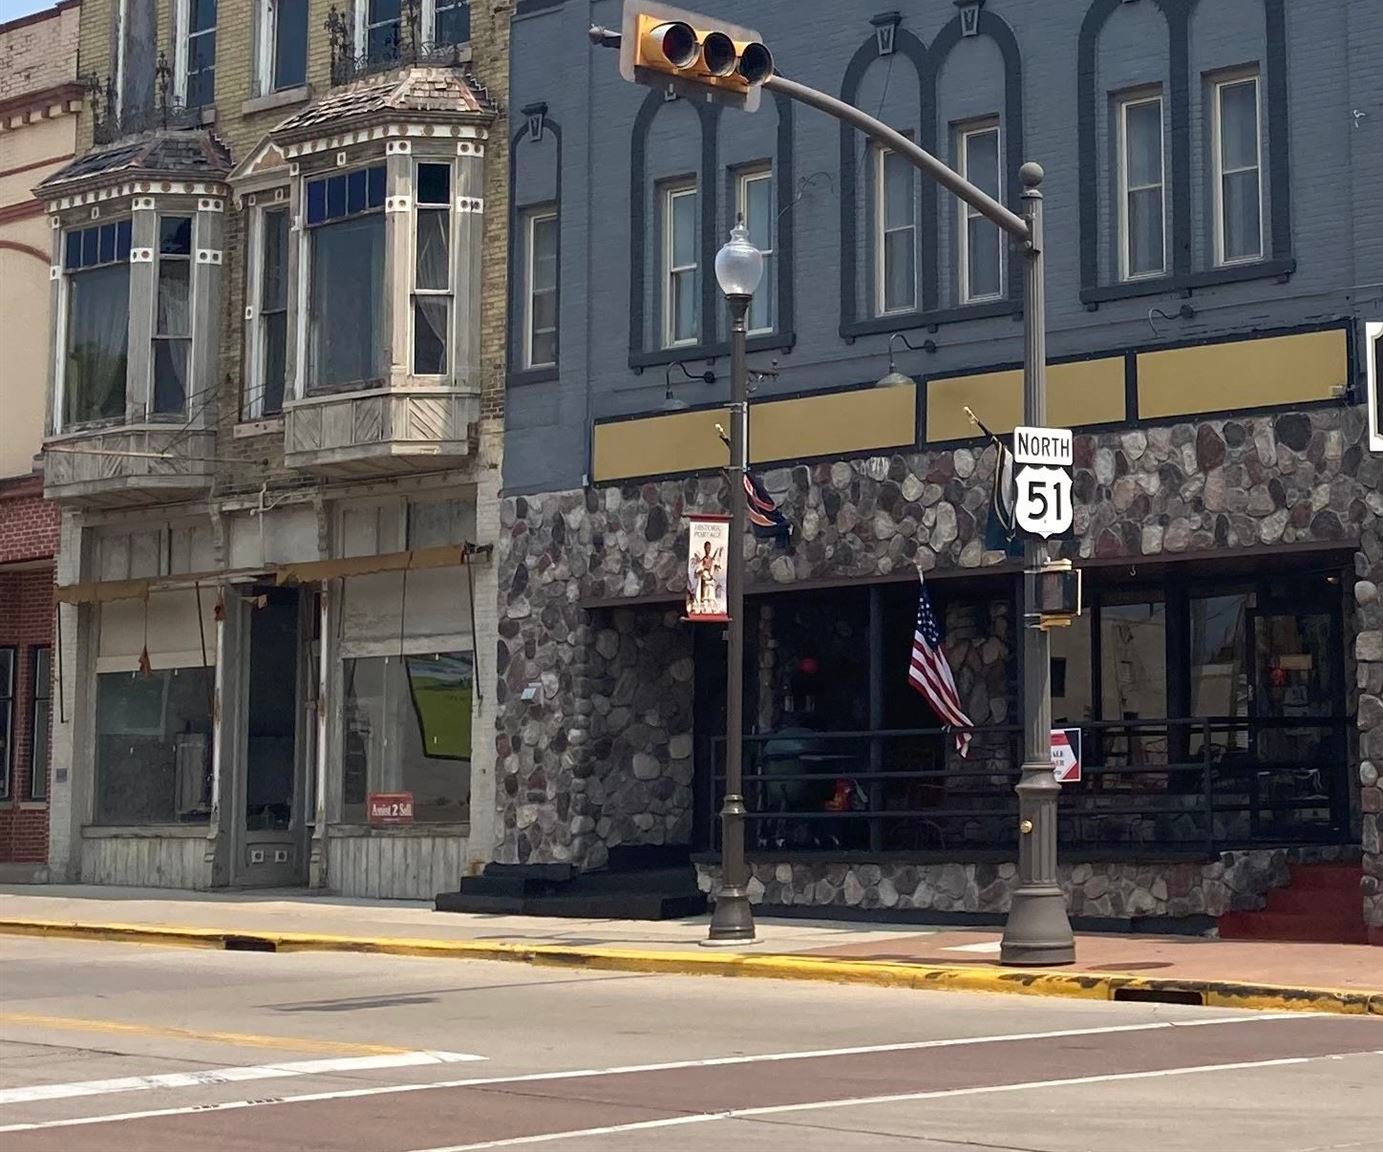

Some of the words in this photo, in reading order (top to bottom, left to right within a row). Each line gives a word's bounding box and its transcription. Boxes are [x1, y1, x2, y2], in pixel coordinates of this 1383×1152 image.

[1018, 432, 1070, 457] NORTH
[1027, 480, 1062, 521] 51
[391, 804, 399, 816] 2
